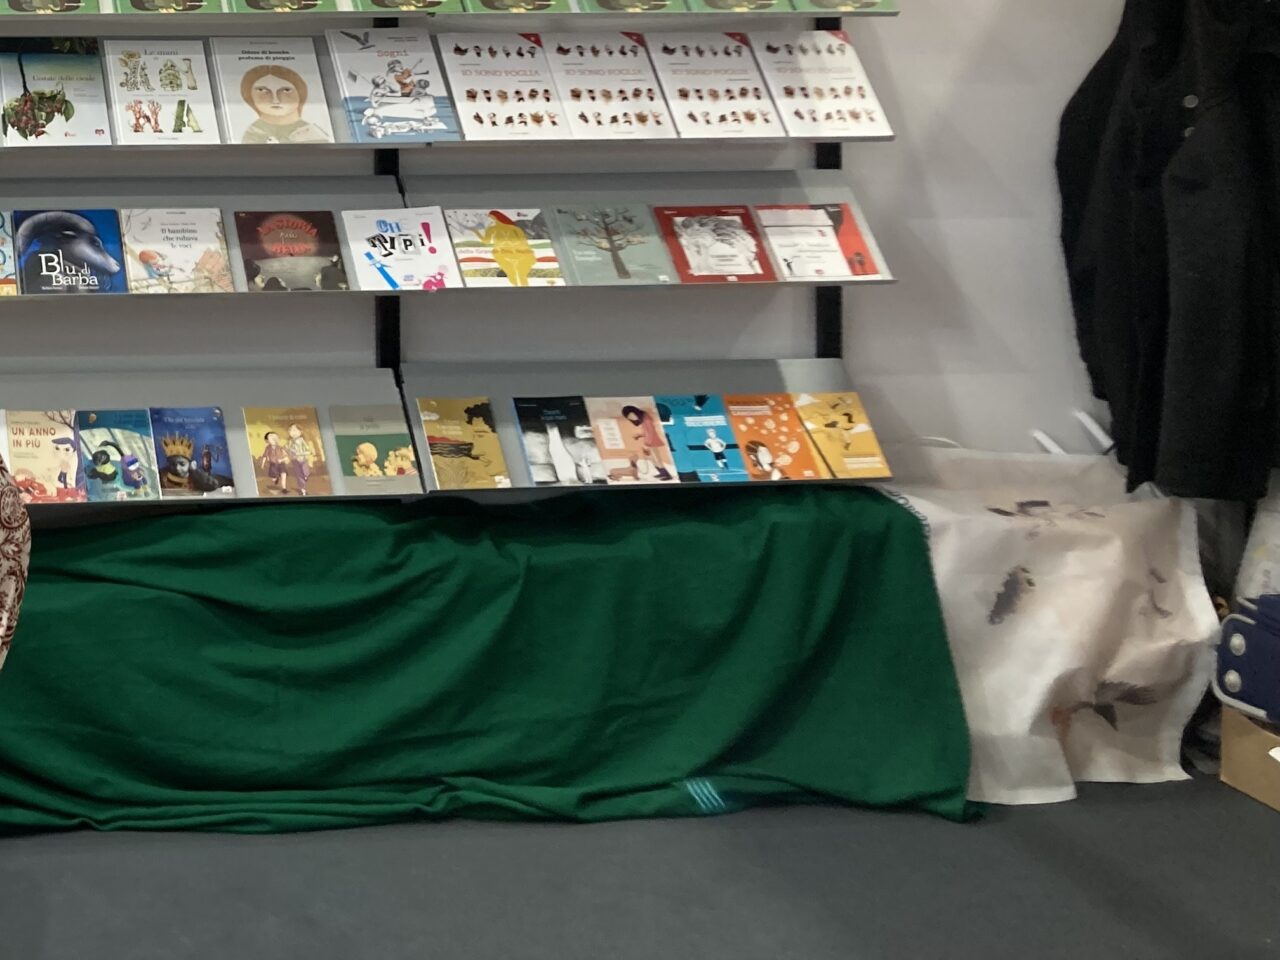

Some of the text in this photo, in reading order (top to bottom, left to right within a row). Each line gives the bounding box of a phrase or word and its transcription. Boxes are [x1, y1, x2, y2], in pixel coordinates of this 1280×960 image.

[38, 249, 91, 275] Blu di
[52, 273, 98, 285] Barba
[12, 427, 56, 436] UN ANNO
